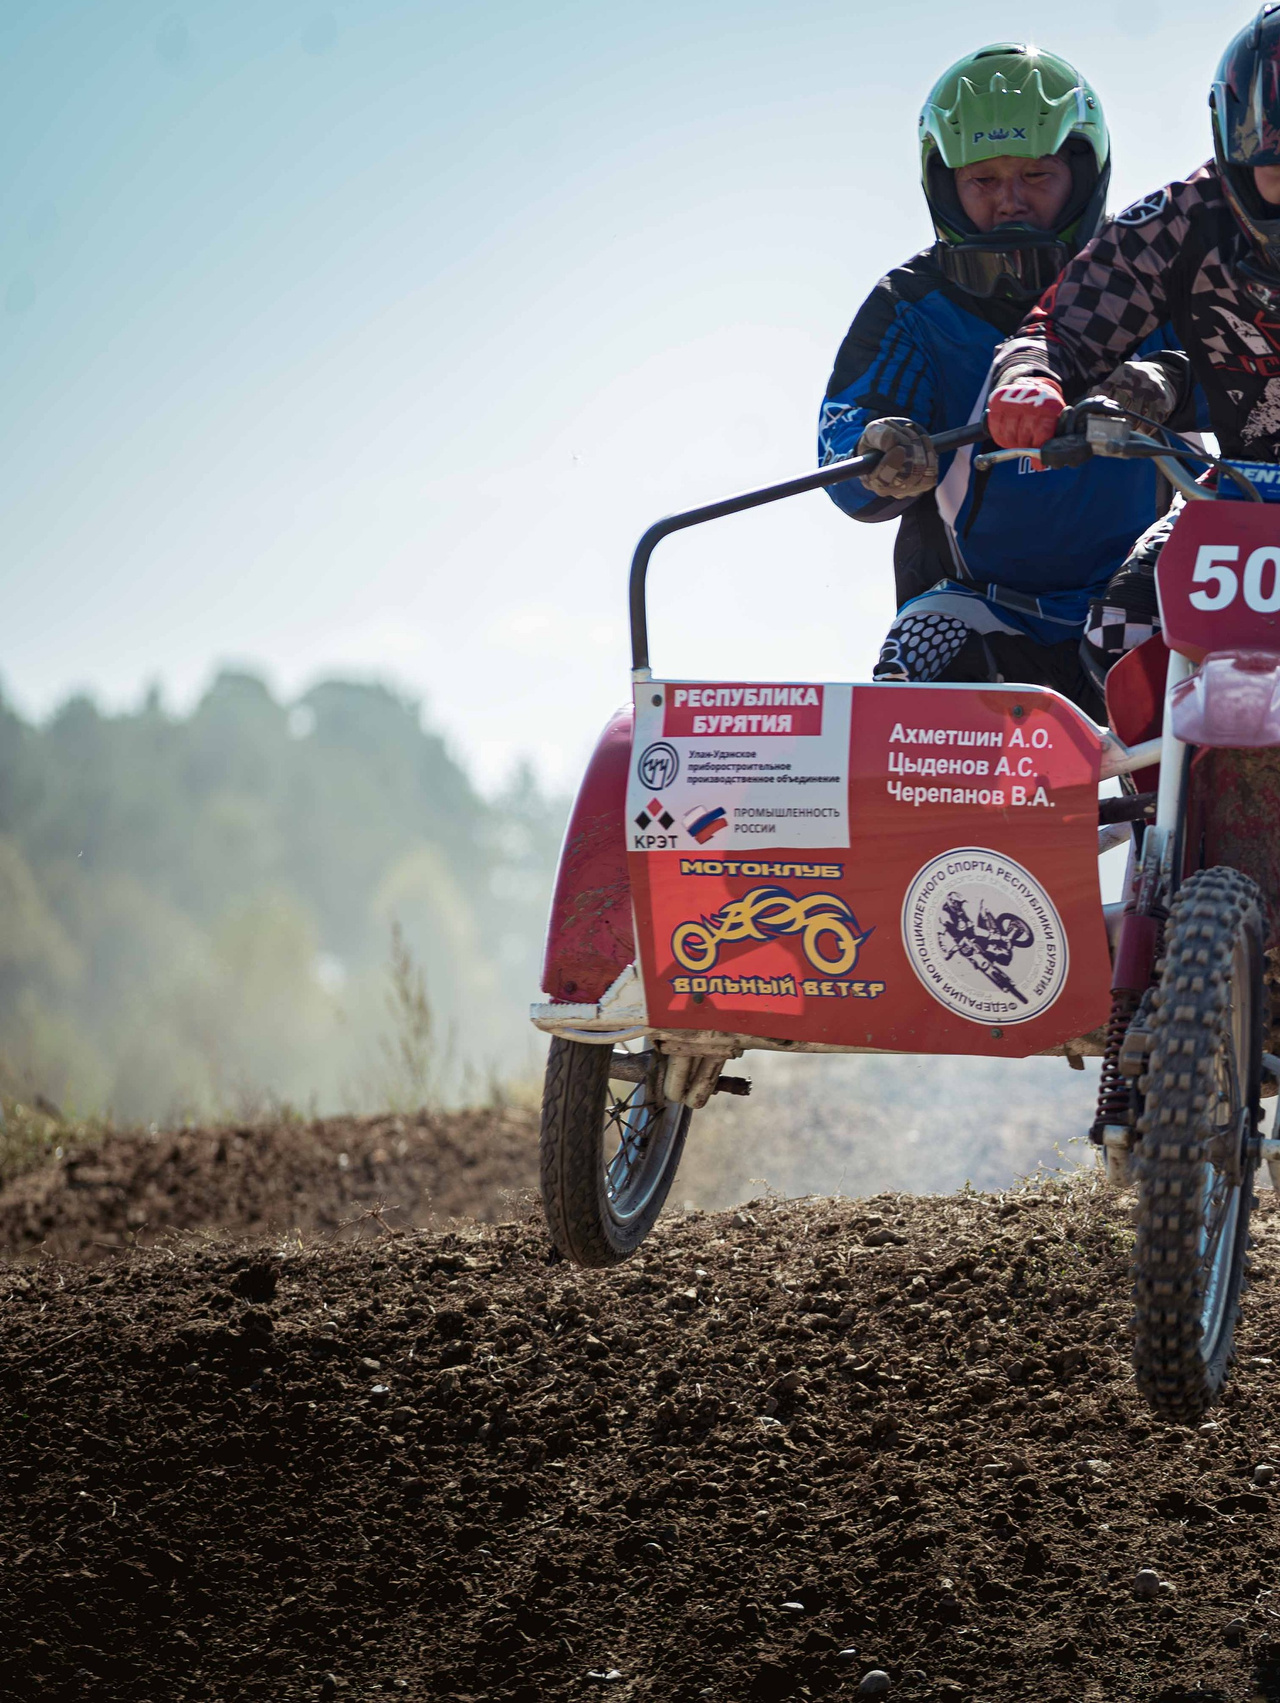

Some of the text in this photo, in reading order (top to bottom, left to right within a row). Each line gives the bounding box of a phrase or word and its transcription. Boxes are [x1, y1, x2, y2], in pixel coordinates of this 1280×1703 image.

[674, 688, 819, 707] РЕСПУБЛИКА
[692, 714, 792, 734] БУРЯТИЯ
[889, 723, 1053, 749] Ахметшин А.О.
[688, 750, 757, 759] Улан-Удэнское
[687, 763, 792, 772] приборостроительное
[888, 752, 1038, 777] Цыденов А.С.
[687, 775, 841, 785] производственное объединение
[887, 781, 1055, 808] Черепанов В.А.
[734, 808, 840, 818] ПРОМЫШЛЕННОСТЬ
[734, 824, 776, 833] РОССИИ
[634, 835, 678, 849] КРЭТ
[680, 860, 843, 879] МОТОКЛУБ
[912, 860, 1056, 1013] ФЕДЕРАЦИЯ МОТОЦИКЛЕТНОГО СПОРТА РЕСПУБЛИКИ БУРЯТИЯ
[671, 974, 886, 998] ВОЛЬНЫЙ ВЕТЕР
